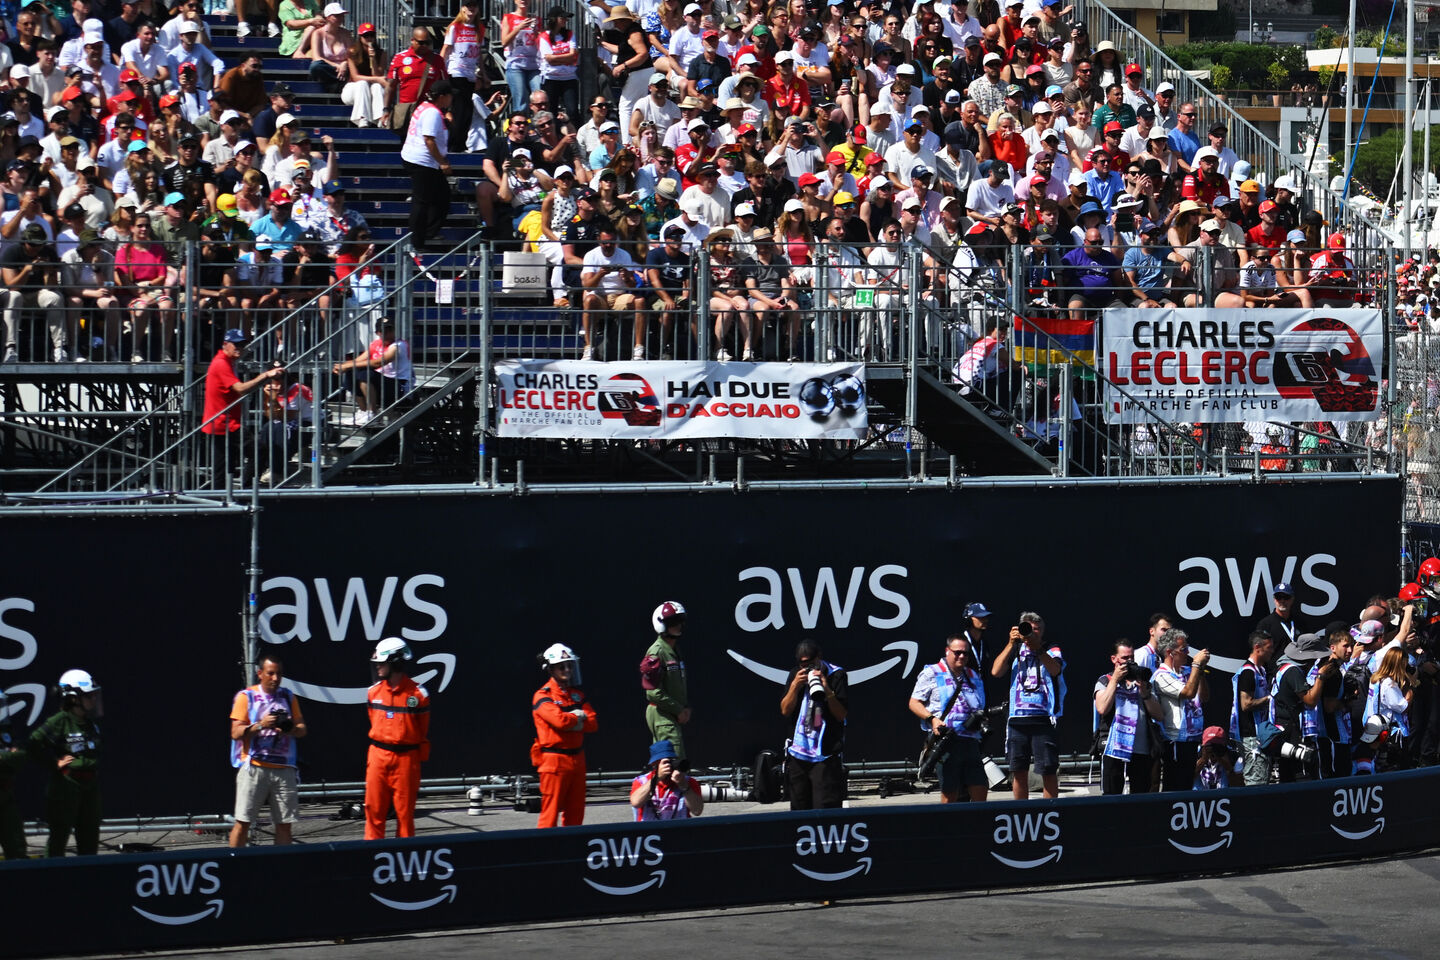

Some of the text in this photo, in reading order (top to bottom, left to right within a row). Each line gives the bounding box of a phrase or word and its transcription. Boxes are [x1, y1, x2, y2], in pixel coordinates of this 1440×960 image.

[1133, 321, 1275, 348] CHARLES
[514, 373, 598, 389] CHARLES
[1109, 351, 1270, 385] LECLERC
[1291, 354, 1329, 383] 6
[501, 390, 596, 410] LECLERC
[667, 380, 790, 398] HAI DUE
[1145, 389, 1258, 398] THE OFFICIAL
[667, 402, 800, 419] D'ACCIAIO
[1124, 400, 1278, 410] MARCHE FAN CLUB
[735, 565, 910, 631] aws
[1175, 554, 1339, 619] aws
[258, 574, 447, 643] aws
[1171, 799, 1230, 830] aws
[1333, 786, 1383, 817] aws
[796, 823, 869, 855] aws
[994, 812, 1059, 844] aws
[373, 849, 454, 884] aws
[587, 835, 665, 874] aws
[136, 862, 220, 897] aws
